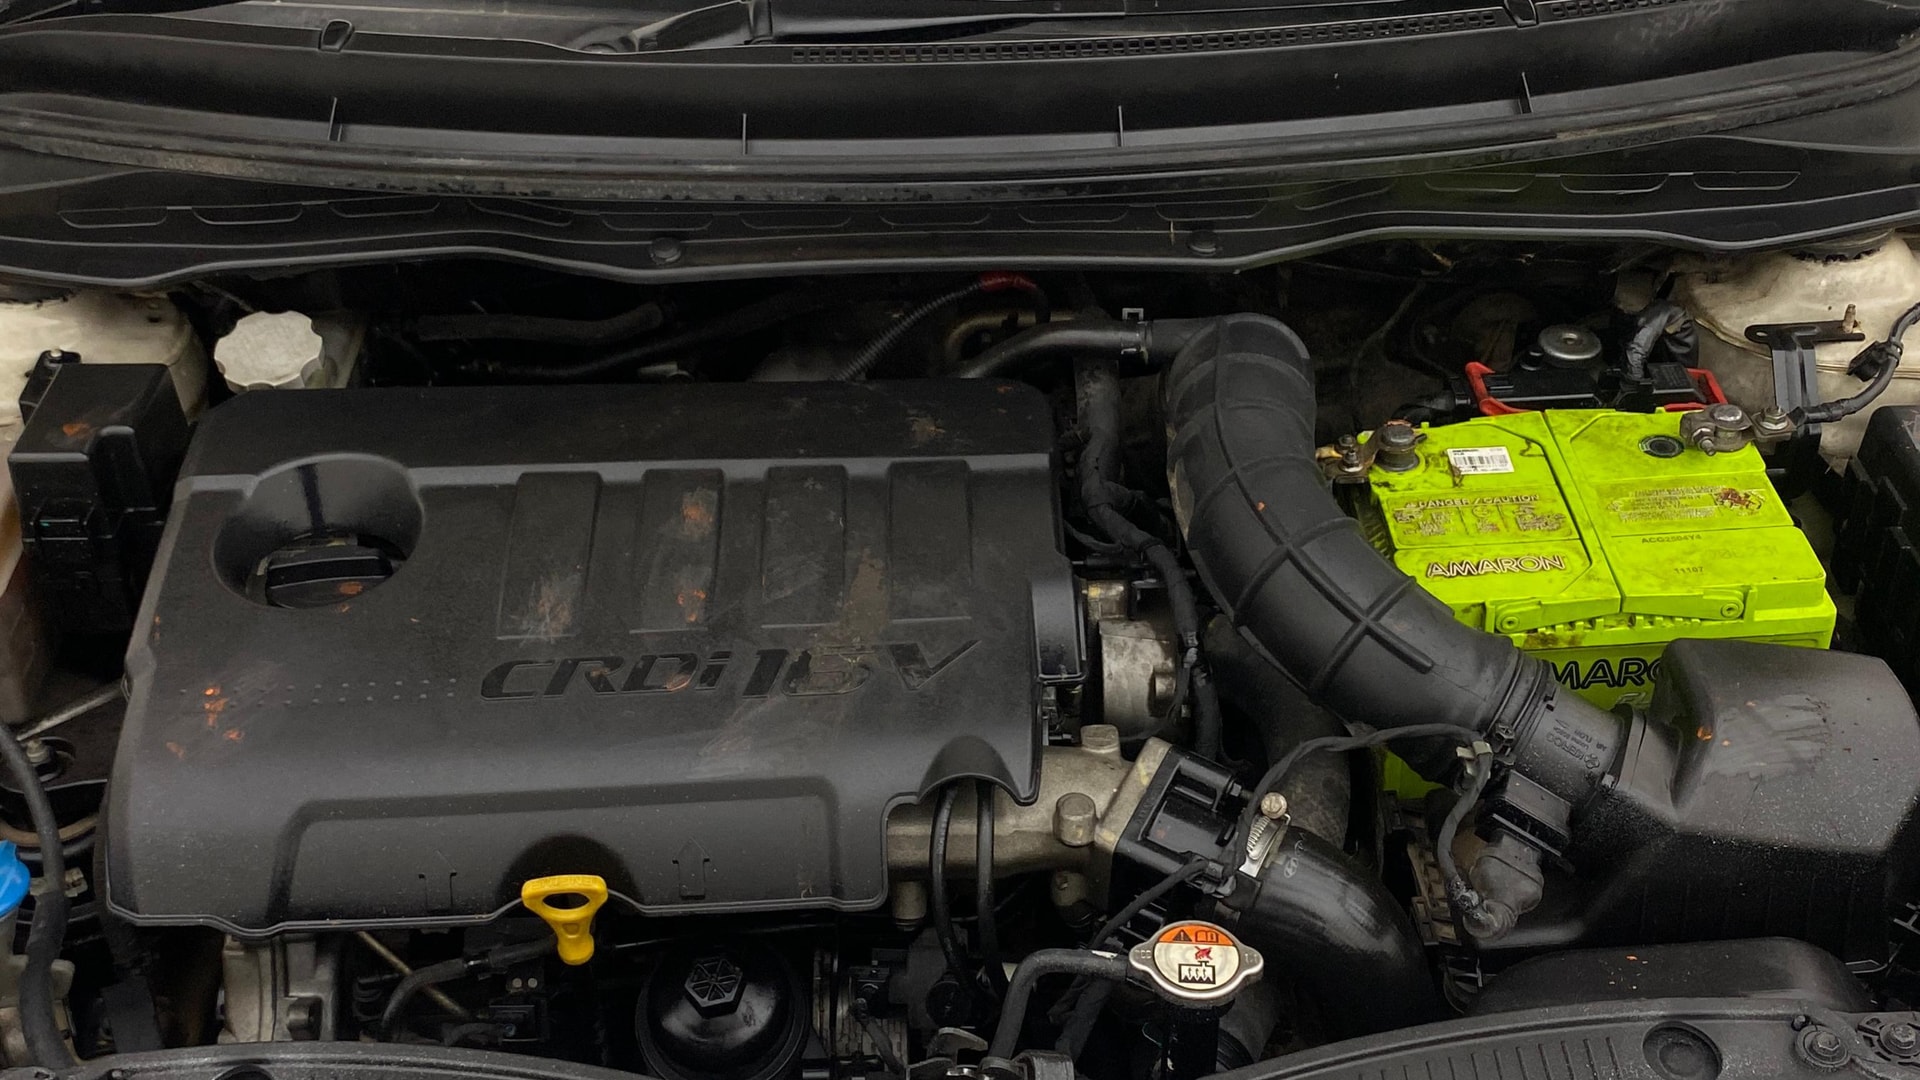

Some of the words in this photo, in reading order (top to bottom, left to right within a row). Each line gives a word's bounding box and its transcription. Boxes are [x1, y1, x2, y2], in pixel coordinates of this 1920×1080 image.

[1418, 498, 1471, 509] DANGER
[1483, 495, 1540, 505] CAUTION
[1427, 554, 1566, 578] AMARON
